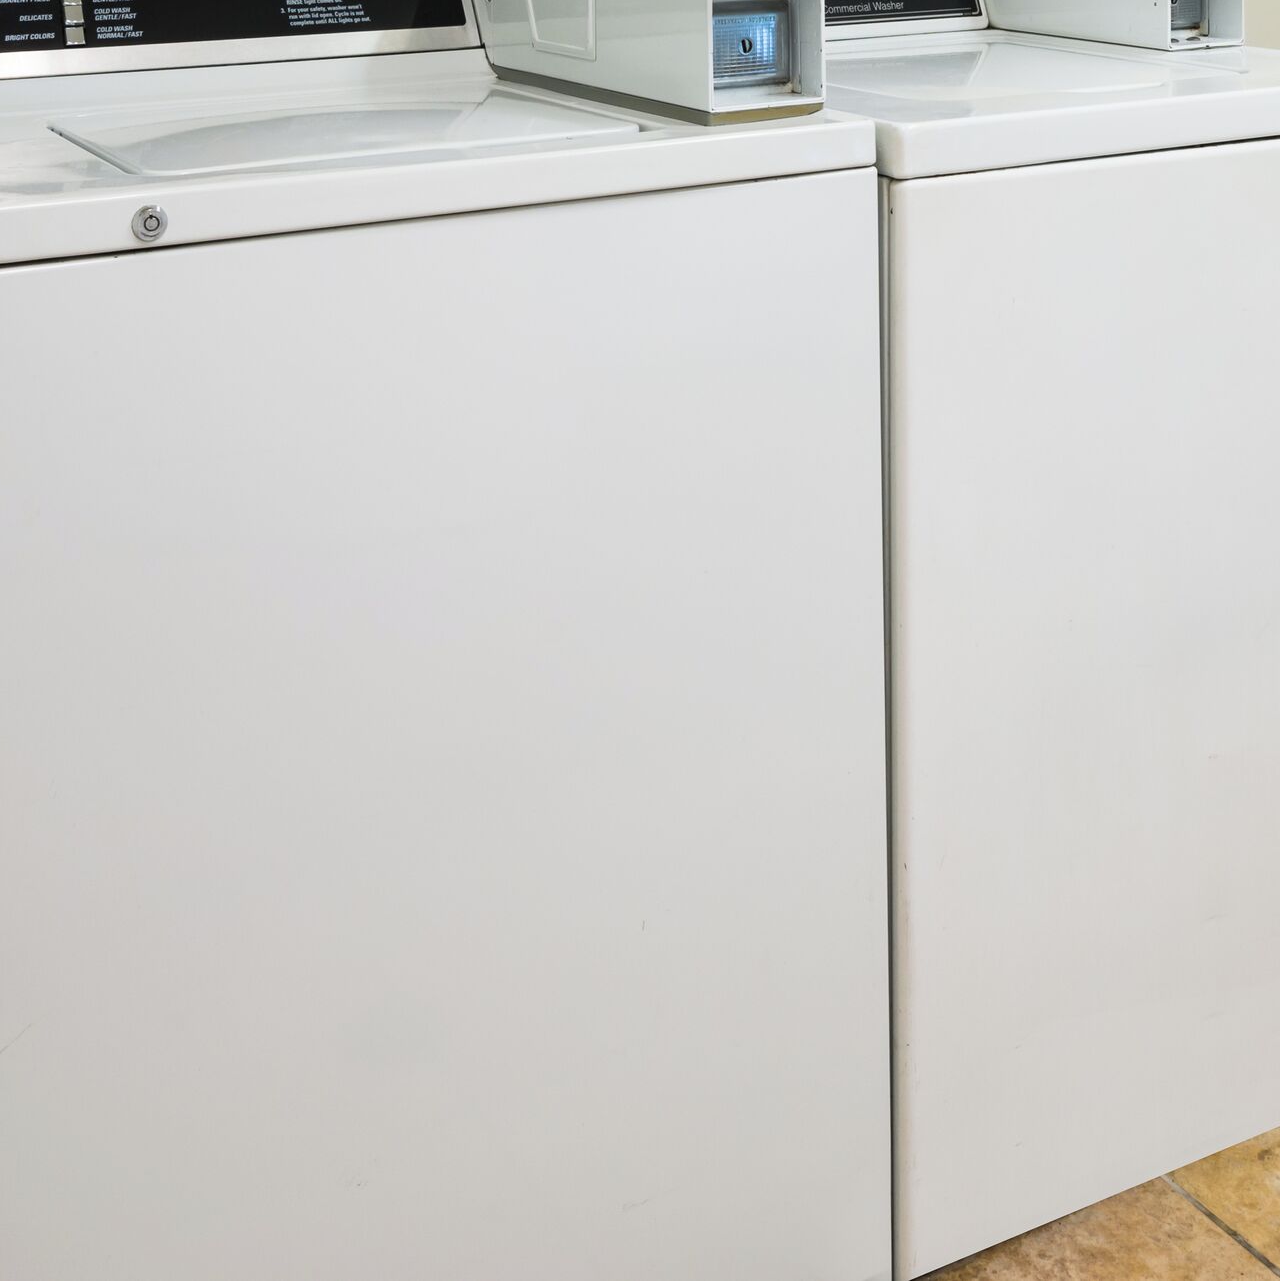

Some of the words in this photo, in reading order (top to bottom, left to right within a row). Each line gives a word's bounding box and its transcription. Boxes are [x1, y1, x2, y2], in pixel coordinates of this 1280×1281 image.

[872, 1, 904, 12] Washer
[19, 14, 53, 22] DELICATES
[4, 34, 29, 42] BRIGHT
